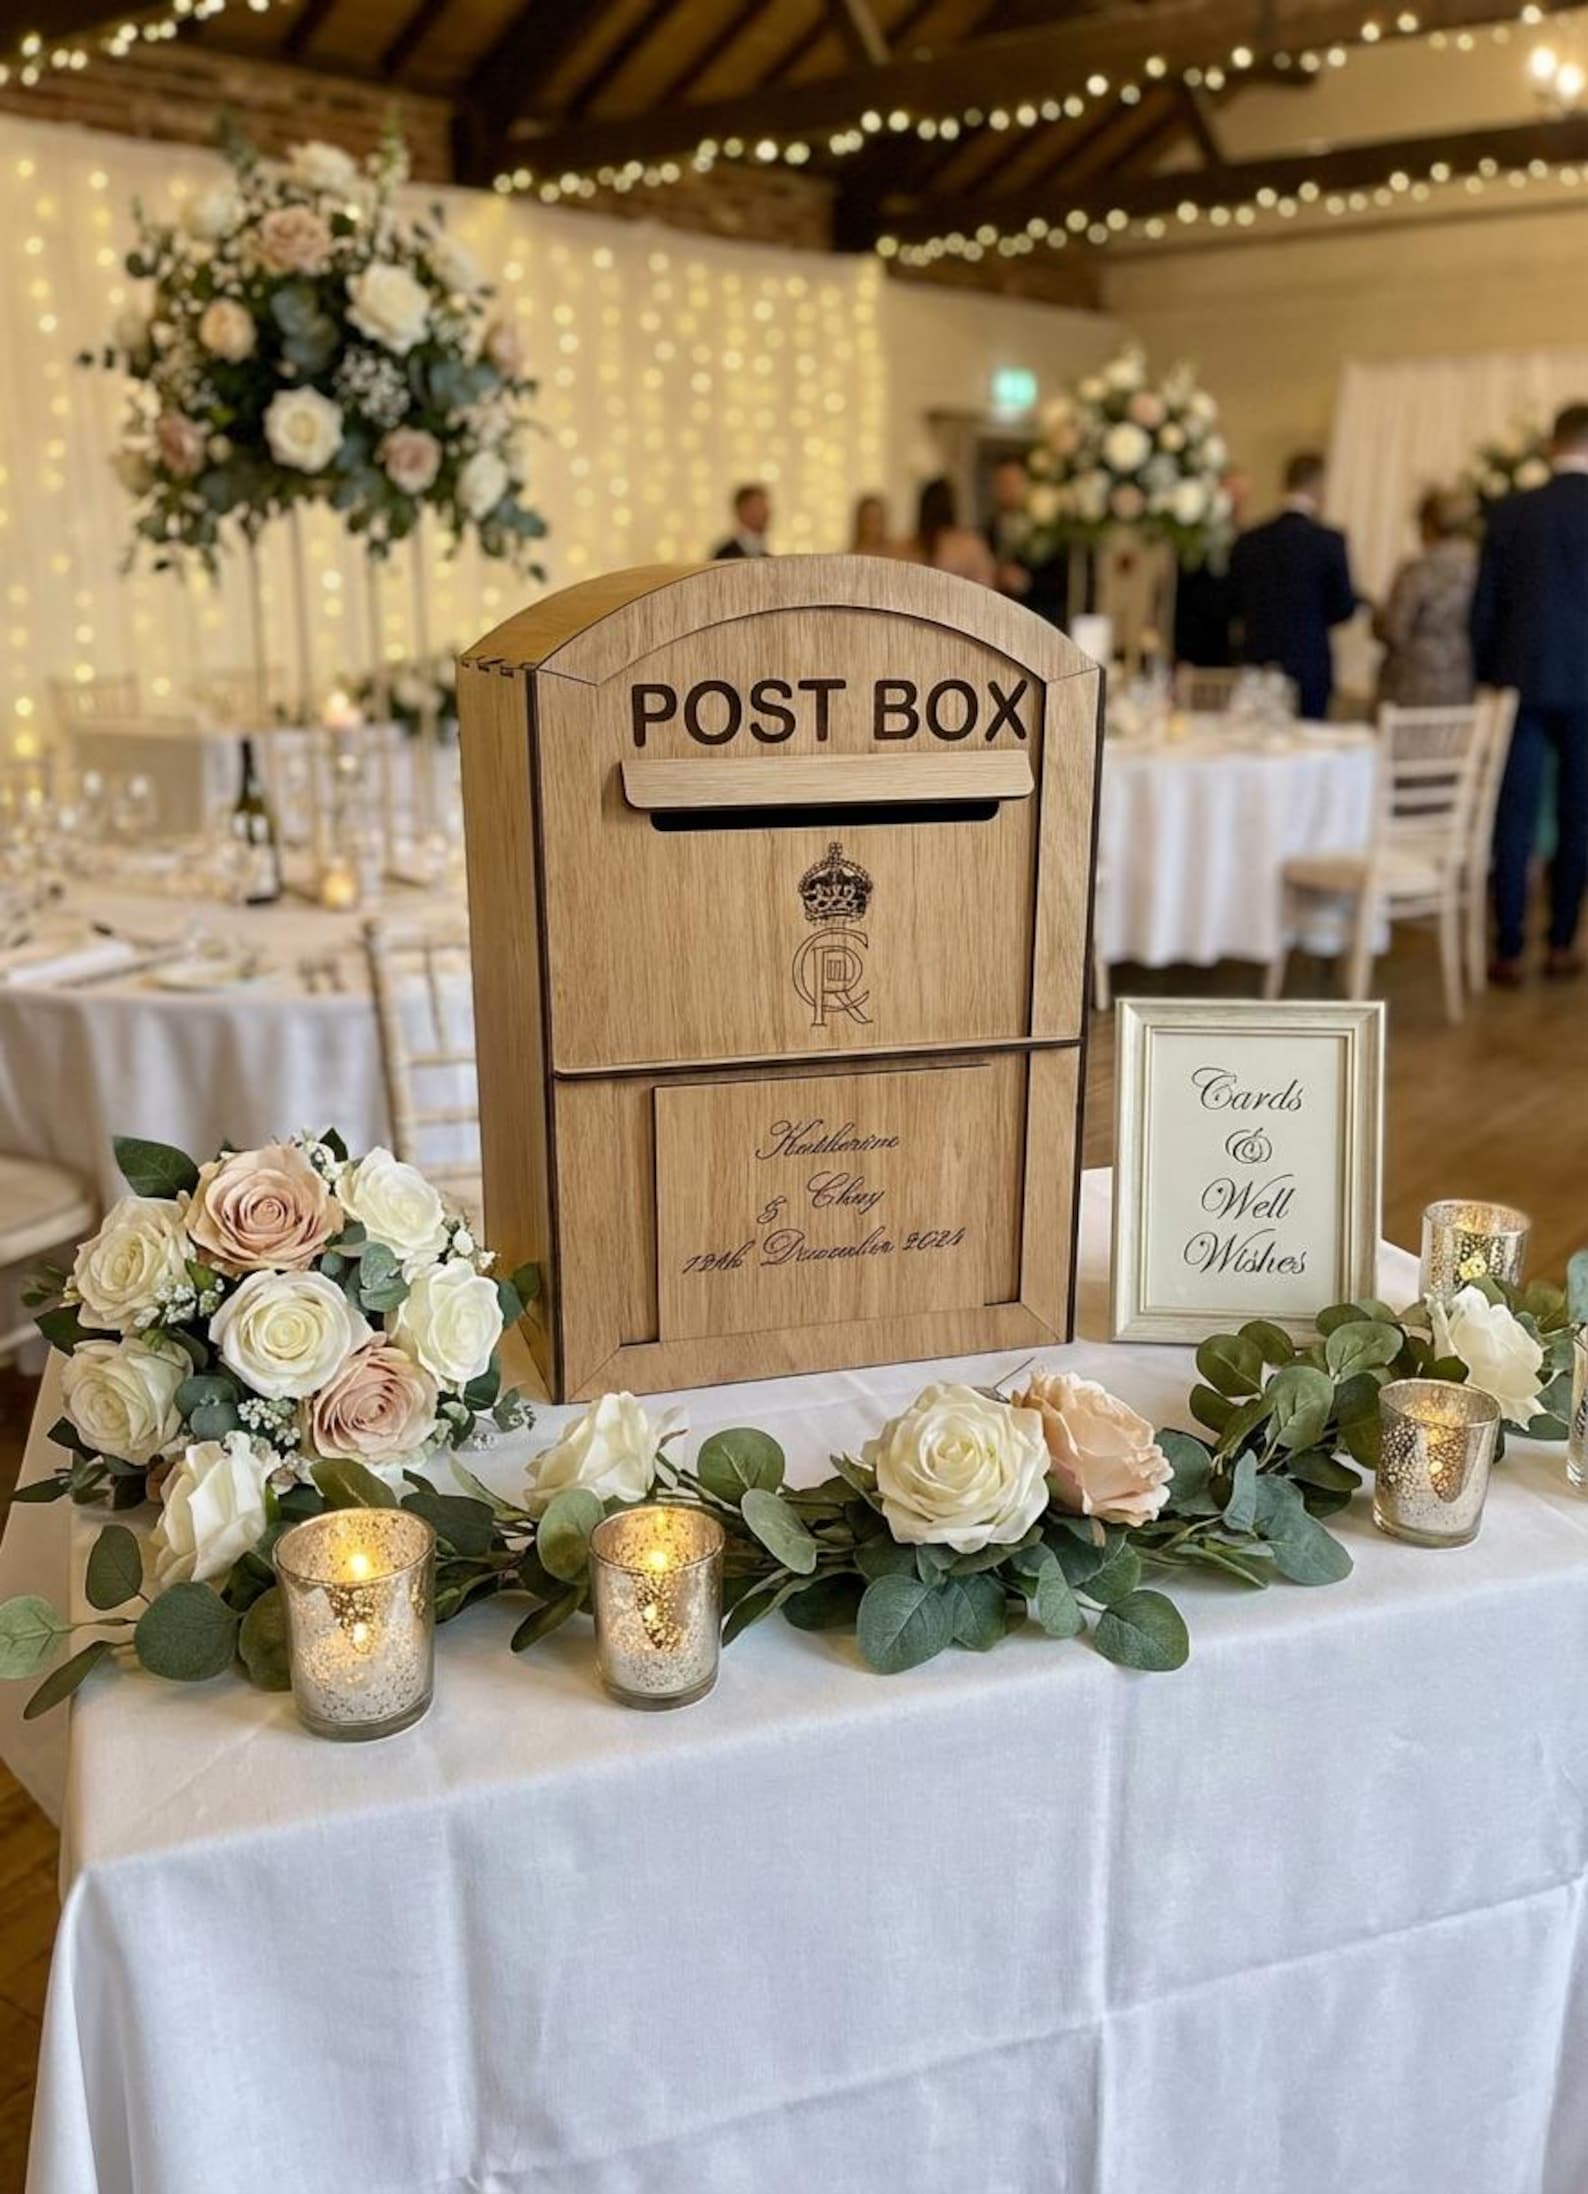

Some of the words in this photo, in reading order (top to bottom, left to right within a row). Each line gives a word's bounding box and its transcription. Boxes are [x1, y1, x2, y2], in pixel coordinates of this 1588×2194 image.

[631, 678, 847, 748] POST
[872, 678, 1028, 743] BOX
[1191, 1066, 1303, 1112] Cards
[1225, 1127, 1273, 1165] &
[1200, 1173, 1296, 1220] Well
[1182, 1227, 1307, 1275] Wishes
